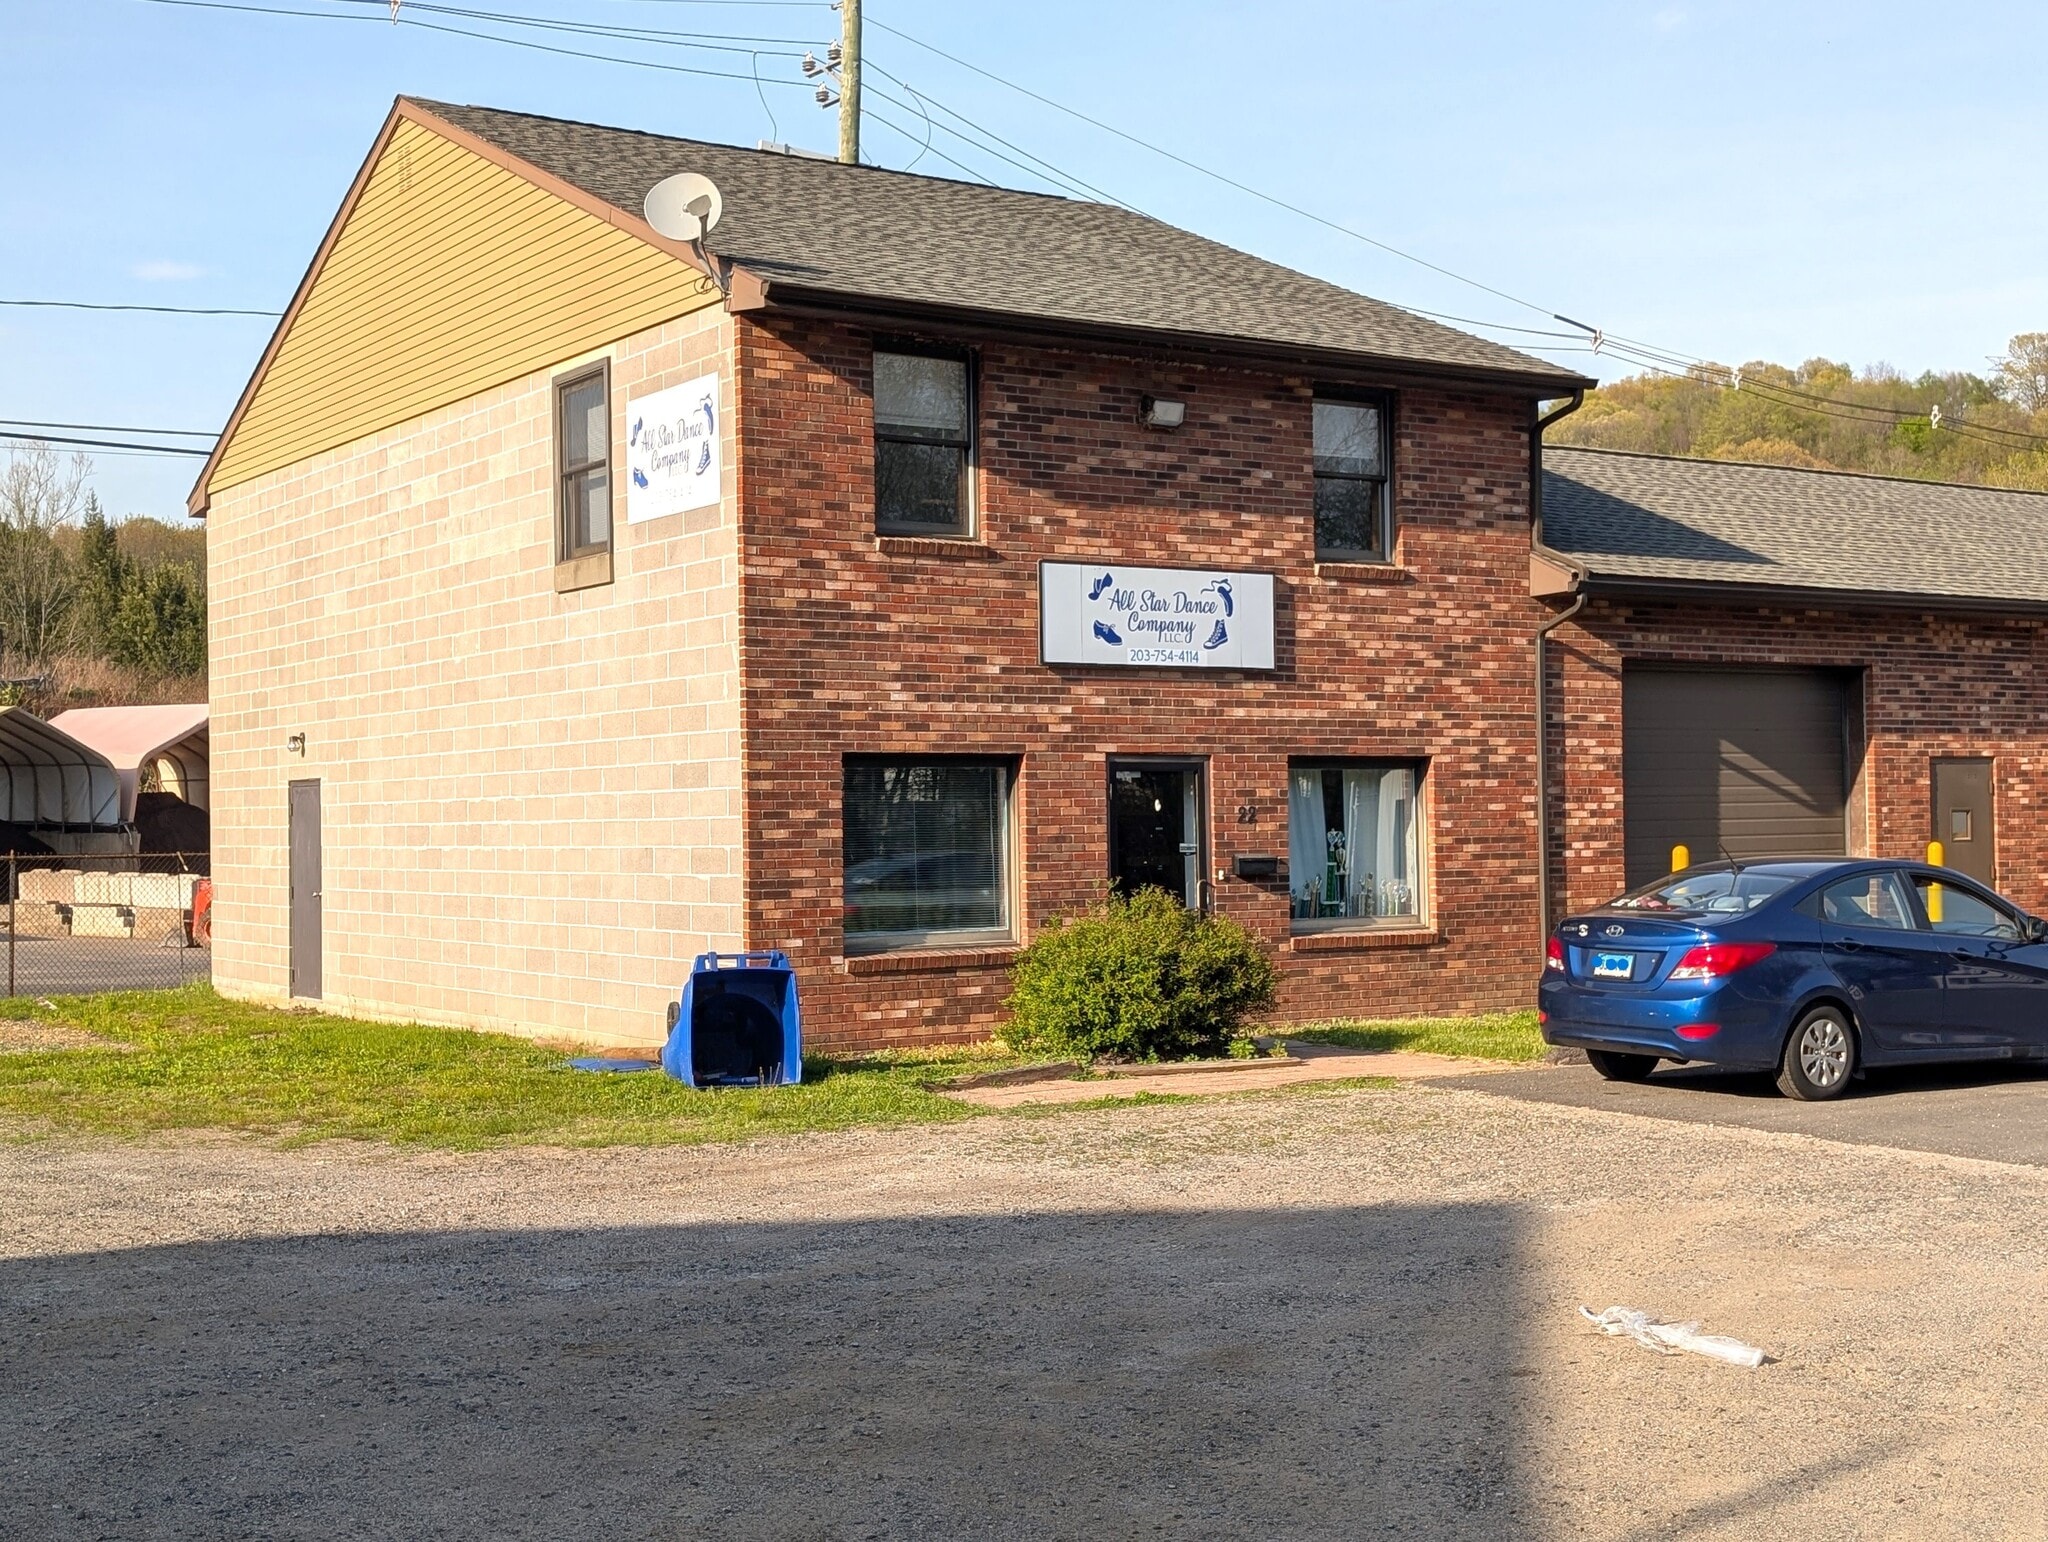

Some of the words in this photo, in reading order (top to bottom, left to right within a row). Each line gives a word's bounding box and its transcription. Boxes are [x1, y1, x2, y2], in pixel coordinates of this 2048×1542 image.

[641, 429, 656, 453] All
[658, 424, 674, 448] Star
[677, 418, 704, 443] Dance
[651, 449, 690, 478] Company
[1107, 588, 1136, 611] All
[1140, 589, 1170, 612] Star
[1173, 591, 1218, 614] Dance
[1127, 611, 1196, 643] Company
[1130, 649, 1199, 663] 203-754-4114
[1238, 806, 1258, 824] 22
